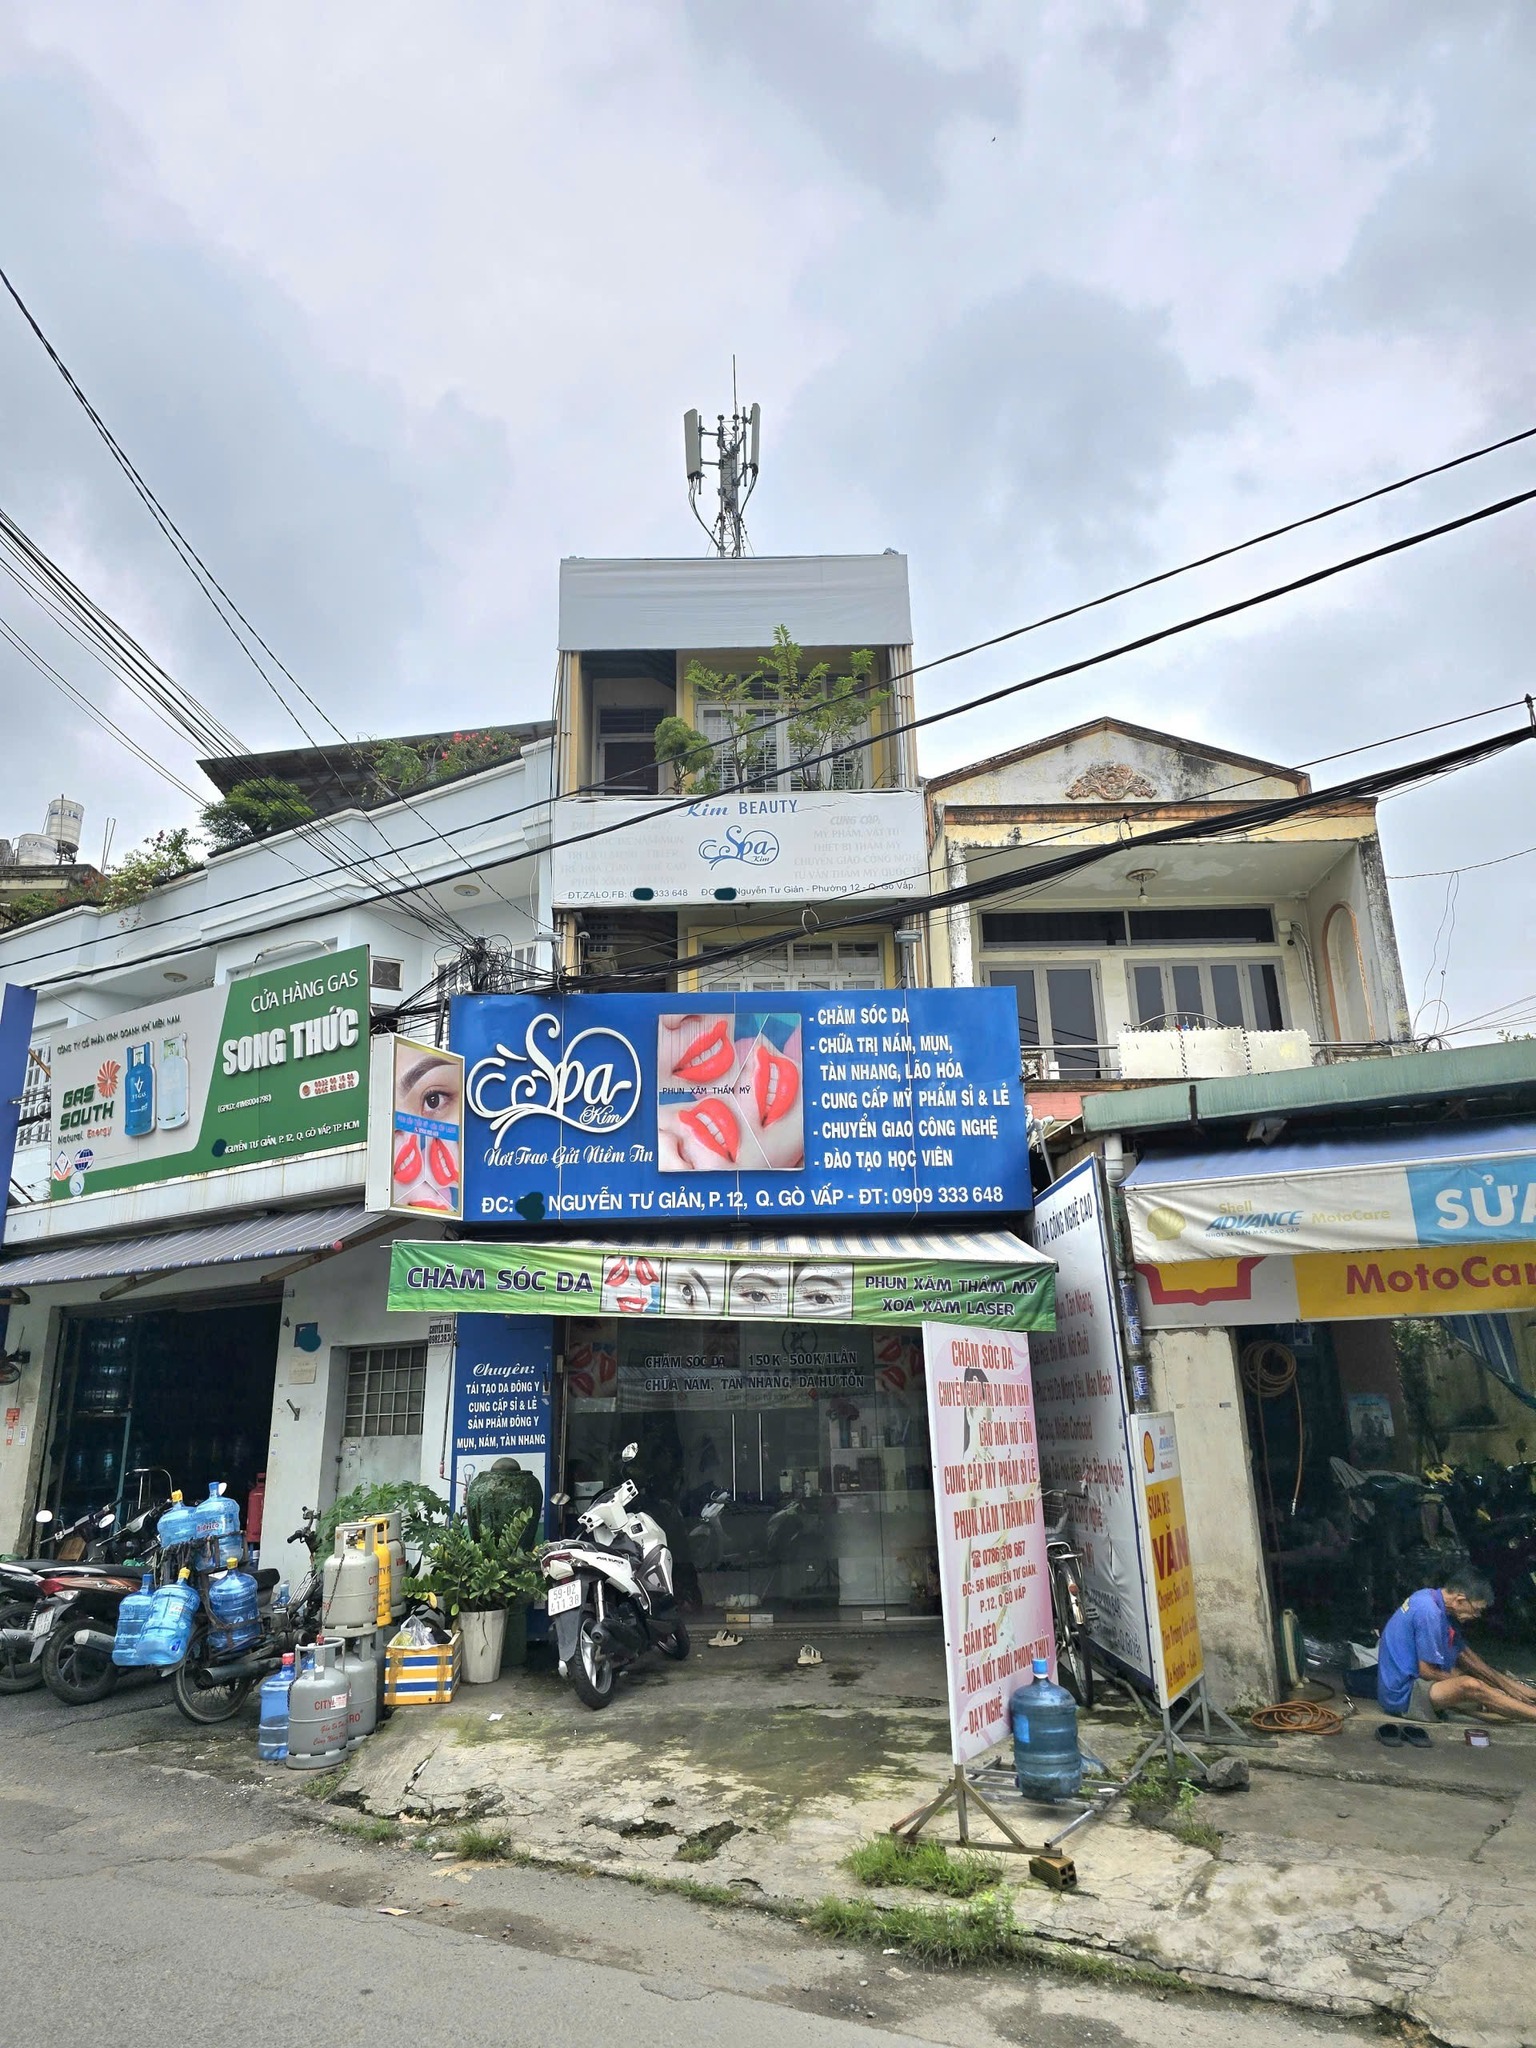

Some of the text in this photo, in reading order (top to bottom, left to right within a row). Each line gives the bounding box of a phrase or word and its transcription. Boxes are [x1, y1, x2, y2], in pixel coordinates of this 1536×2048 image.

[738, 800, 798, 815] BEAUTY
[752, 855, 770, 863] Kim
[672, 889, 688, 897] 648
[769, 886, 781, 894] Tư
[812, 884, 847, 896] Phường
[850, 884, 860, 892] 12
[251, 969, 359, 1013] CỬA HÀNG GAS
[817, 1004, 910, 1025] CHĂM SÓC DA
[222, 1005, 359, 1076] SONG THỨC
[819, 1033, 953, 1057] CHỮA TRỊ NÁM, MỤN,
[820, 1057, 964, 1083] TÀN NHANG, LÃO HÓA
[62, 1084, 96, 1110] GAS
[662, 1084, 751, 1095] PHUN XĂM MỸ
[821, 1081, 1010, 1109] CUNG CẤP MỸ PHẨM SỈ & LẺ
[59, 1100, 115, 1132] SOUTH
[343, 1119, 360, 1131] HCM
[579, 1105, 623, 1125] Kim
[822, 1113, 999, 1139] CHUYỂN GIAO CÔNG NGHỆ
[57, 1132, 84, 1145] Natural
[86, 1126, 112, 1140] Energy
[484, 1144, 654, 1169] Nơi Trao Gửi Niềm Tin
[823, 1146, 953, 1172] ĐÀO TẠO HỌC VIÊN
[481, 1196, 514, 1214] ĐC:
[549, 1186, 623, 1212] NGUYỄN
[629, 1191, 655, 1210] TƯ
[658, 1186, 706, 1211] GIẢN,
[755, 1189, 775, 1207] Q.
[778, 1185, 806, 1207] GÒ
[811, 1182, 844, 1206] VẤP
[859, 1188, 889, 1205] ĐT:
[891, 1188, 934, 1204] 0909
[938, 1187, 969, 1203] 333
[972, 1186, 1003, 1203] 648
[1219, 1200, 1252, 1214] Shell
[1205, 1210, 1304, 1231] ADVANCE
[1311, 1207, 1391, 1225] MotoCare
[406, 1264, 594, 1294] CHĂM SÓC DA
[865, 1275, 1039, 1295] PHUN XĂM THẨM MỸ
[882, 1296, 1016, 1317] XOÁ XĂM LASER
[645, 1353, 682, 1368] CHĂM
[686, 1351, 707, 1368] SÓC
[951, 1338, 980, 1368] CHĂM
[981, 1340, 1000, 1370] SÓC
[1001, 1346, 1014, 1370] DA
[473, 1363, 535, 1378] Chuyên:
[466, 1380, 540, 1396] TÁI TẠO DA ĐÔNG Y
[684, 1376, 714, 1392] NÁM,
[720, 1375, 743, 1390] TÀN
[748, 1376, 793, 1389] NHANG,
[799, 1376, 816, 1388] DA
[819, 1374, 837, 1388] HƯ
[468, 1401, 491, 1413] CUNG
[492, 1397, 508, 1412] CẤP
[519, 1400, 526, 1411] &
[527, 1395, 538, 1410] LẺ
[467, 1412, 540, 1430] SẢN PHẨM ĐÔNG Y
[457, 1433, 546, 1452] MỤN, NÁM, TÀN NHANG
[944, 1464, 967, 1496] CUNG
[953, 1500, 1000, 1541] PHUN XĂM
[1152, 1522, 1190, 1580] VĂN
[975, 1578, 985, 1593] 56
[963, 1619, 998, 1657] GIẢM BÉO
[966, 1663, 982, 1695] XÓA
[982, 1653, 996, 1686] NỐT
[996, 1645, 1014, 1680] RUỒI
[1013, 1643, 1034, 1672] PHONG
[968, 1686, 1004, 1738] DẠY NGHỀ
